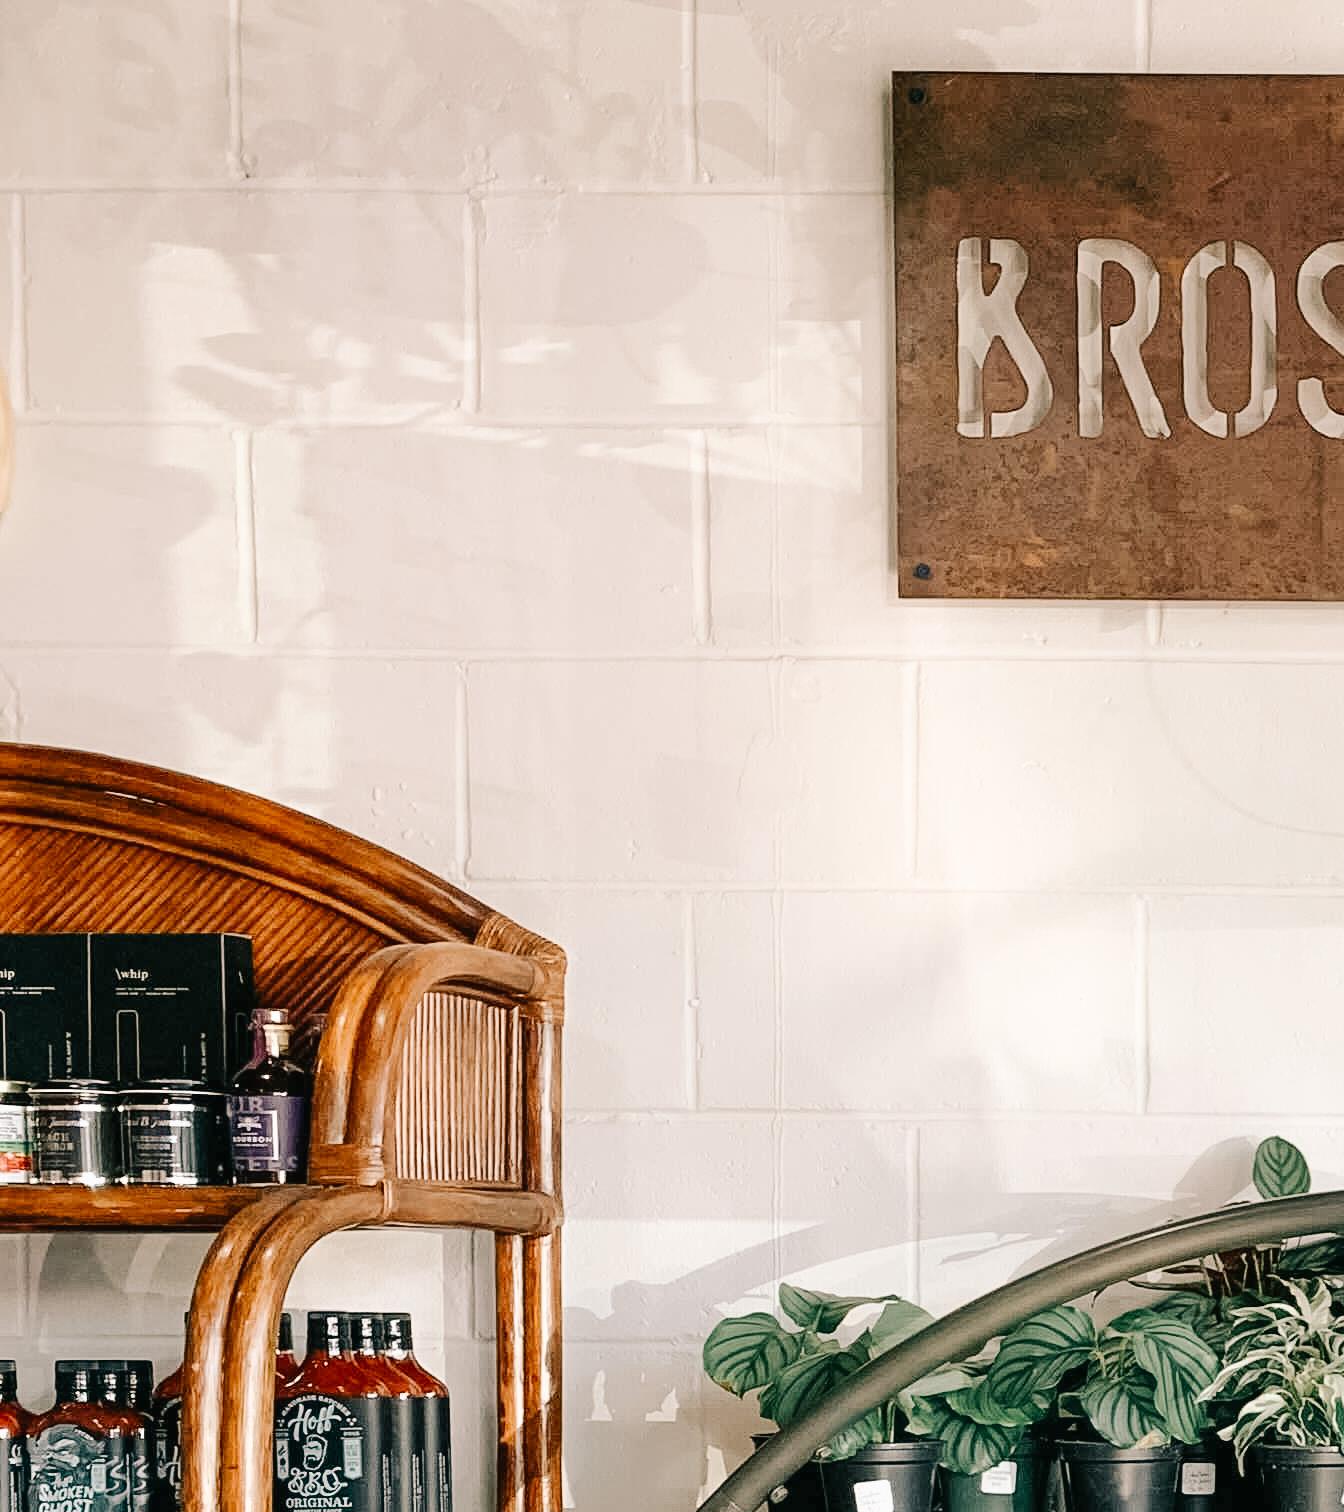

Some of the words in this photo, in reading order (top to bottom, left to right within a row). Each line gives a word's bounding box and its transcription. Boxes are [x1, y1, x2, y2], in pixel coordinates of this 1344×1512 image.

[288, 1404, 342, 1441] Hoff
[288, 1467, 348, 1497] BBQ
[286, 1497, 353, 1509] ORIGINAL
